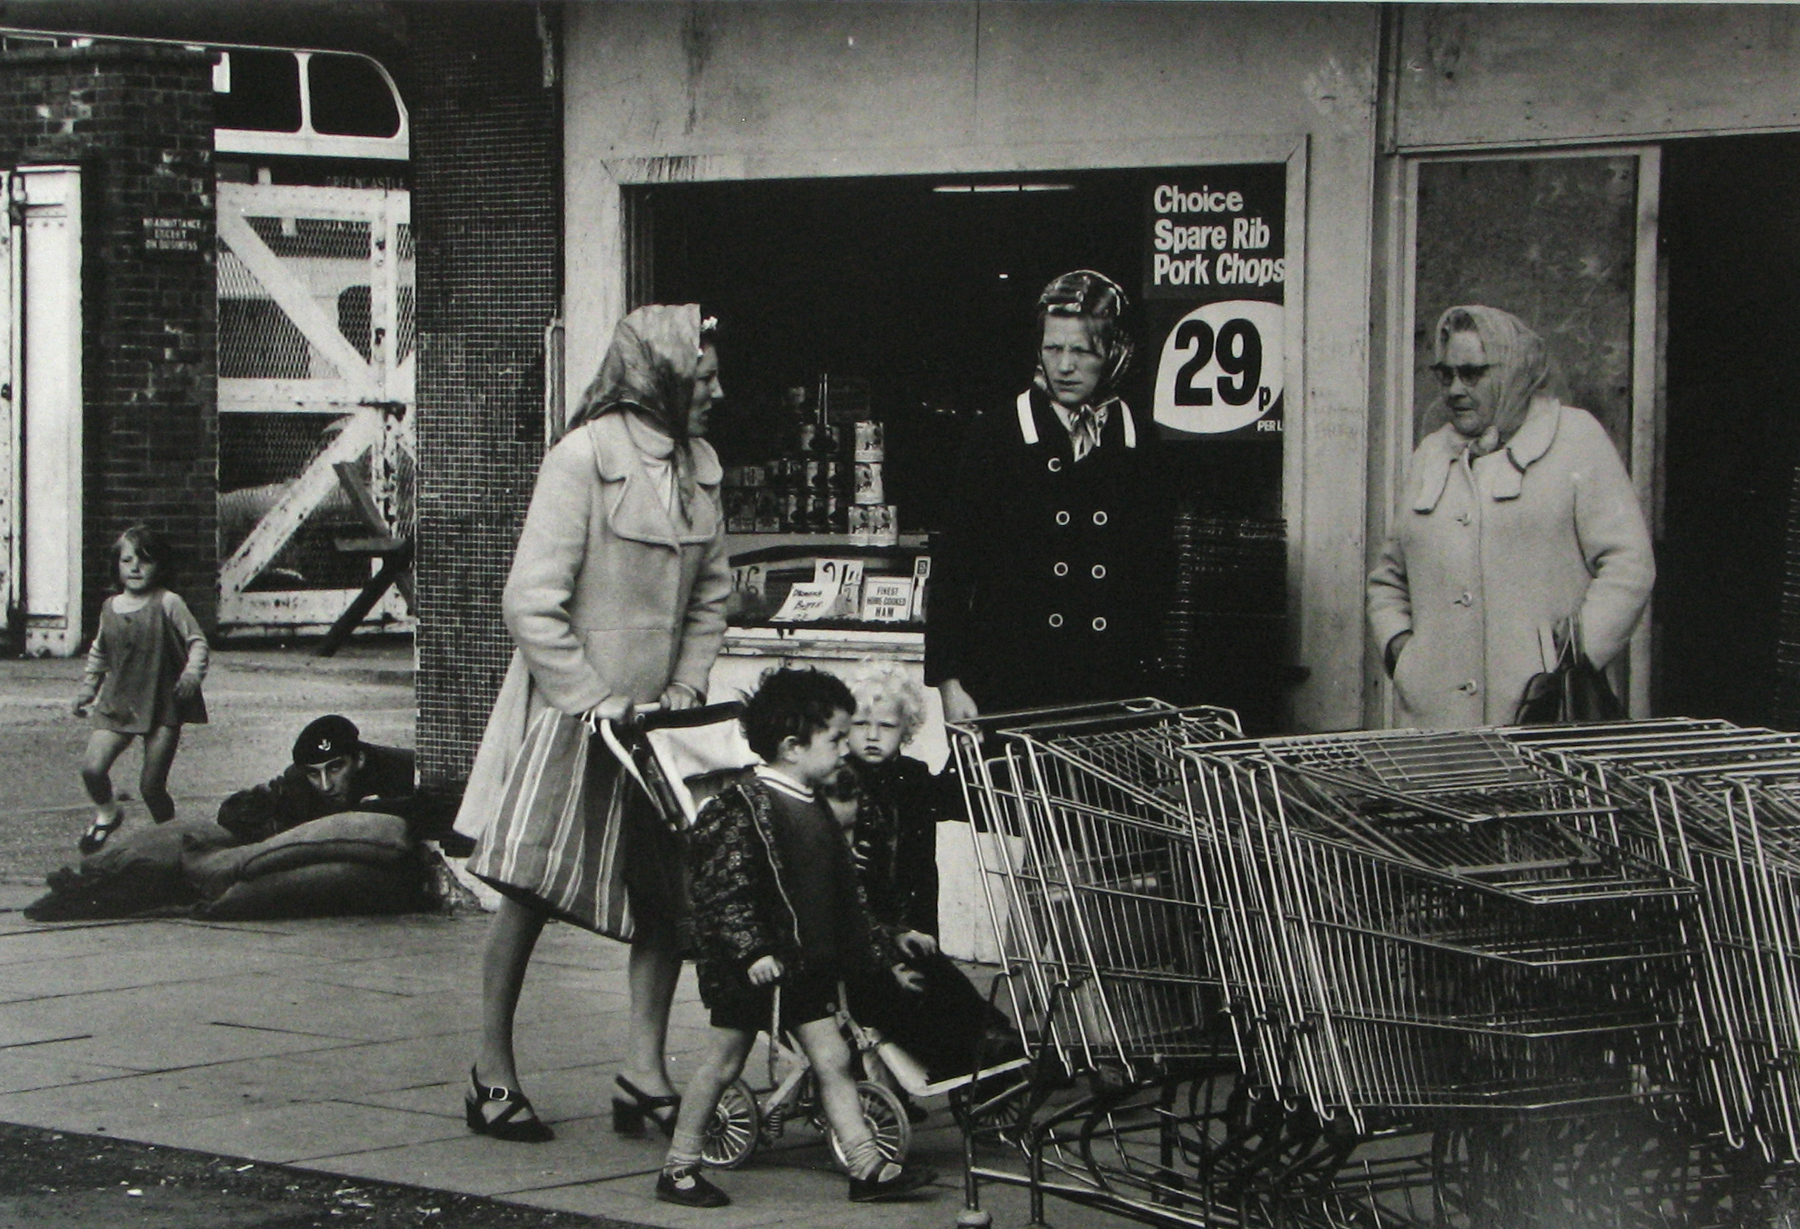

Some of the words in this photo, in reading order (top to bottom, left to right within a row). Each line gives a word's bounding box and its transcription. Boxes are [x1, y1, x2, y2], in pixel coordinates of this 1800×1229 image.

[1153, 185, 1243, 213] Choice
[1153, 218, 1228, 254] Spare
[1232, 217, 1270, 249] Rib
[1153, 253, 1210, 285] Pork
[1216, 252, 1285, 287] Chops
[1256, 419, 1276, 431] PER
[876, 586, 899, 596] FINEST
[874, 606, 894, 618] HAM
